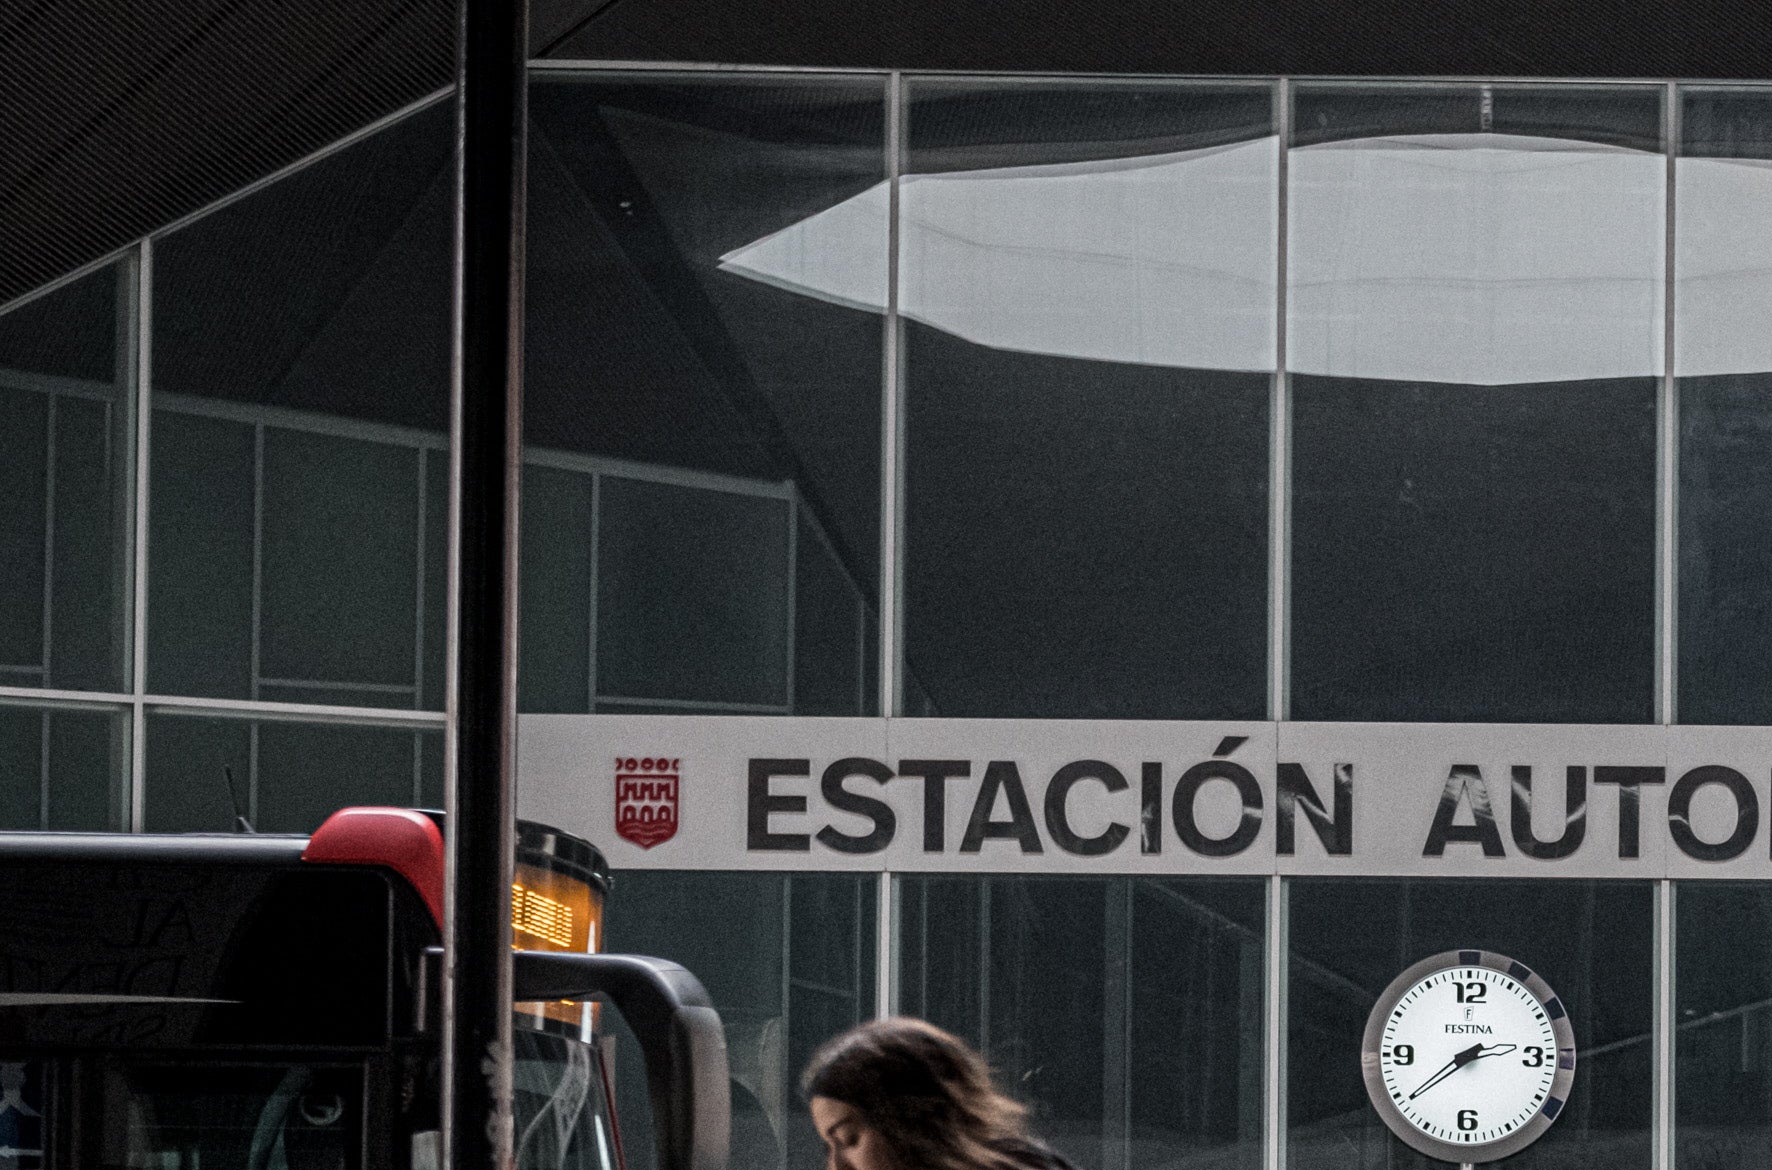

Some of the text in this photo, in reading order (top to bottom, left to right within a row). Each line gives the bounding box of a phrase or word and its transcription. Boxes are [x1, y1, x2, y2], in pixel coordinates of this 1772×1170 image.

[746, 735, 1354, 858] ESTACIÓN
[1452, 981, 1487, 1004] 12
[1445, 1024, 1493, 1035] FESTINA
[1393, 1044, 1415, 1066] 9
[1522, 1046, 1544, 1068] 3
[1457, 1109, 1479, 1131] 6
